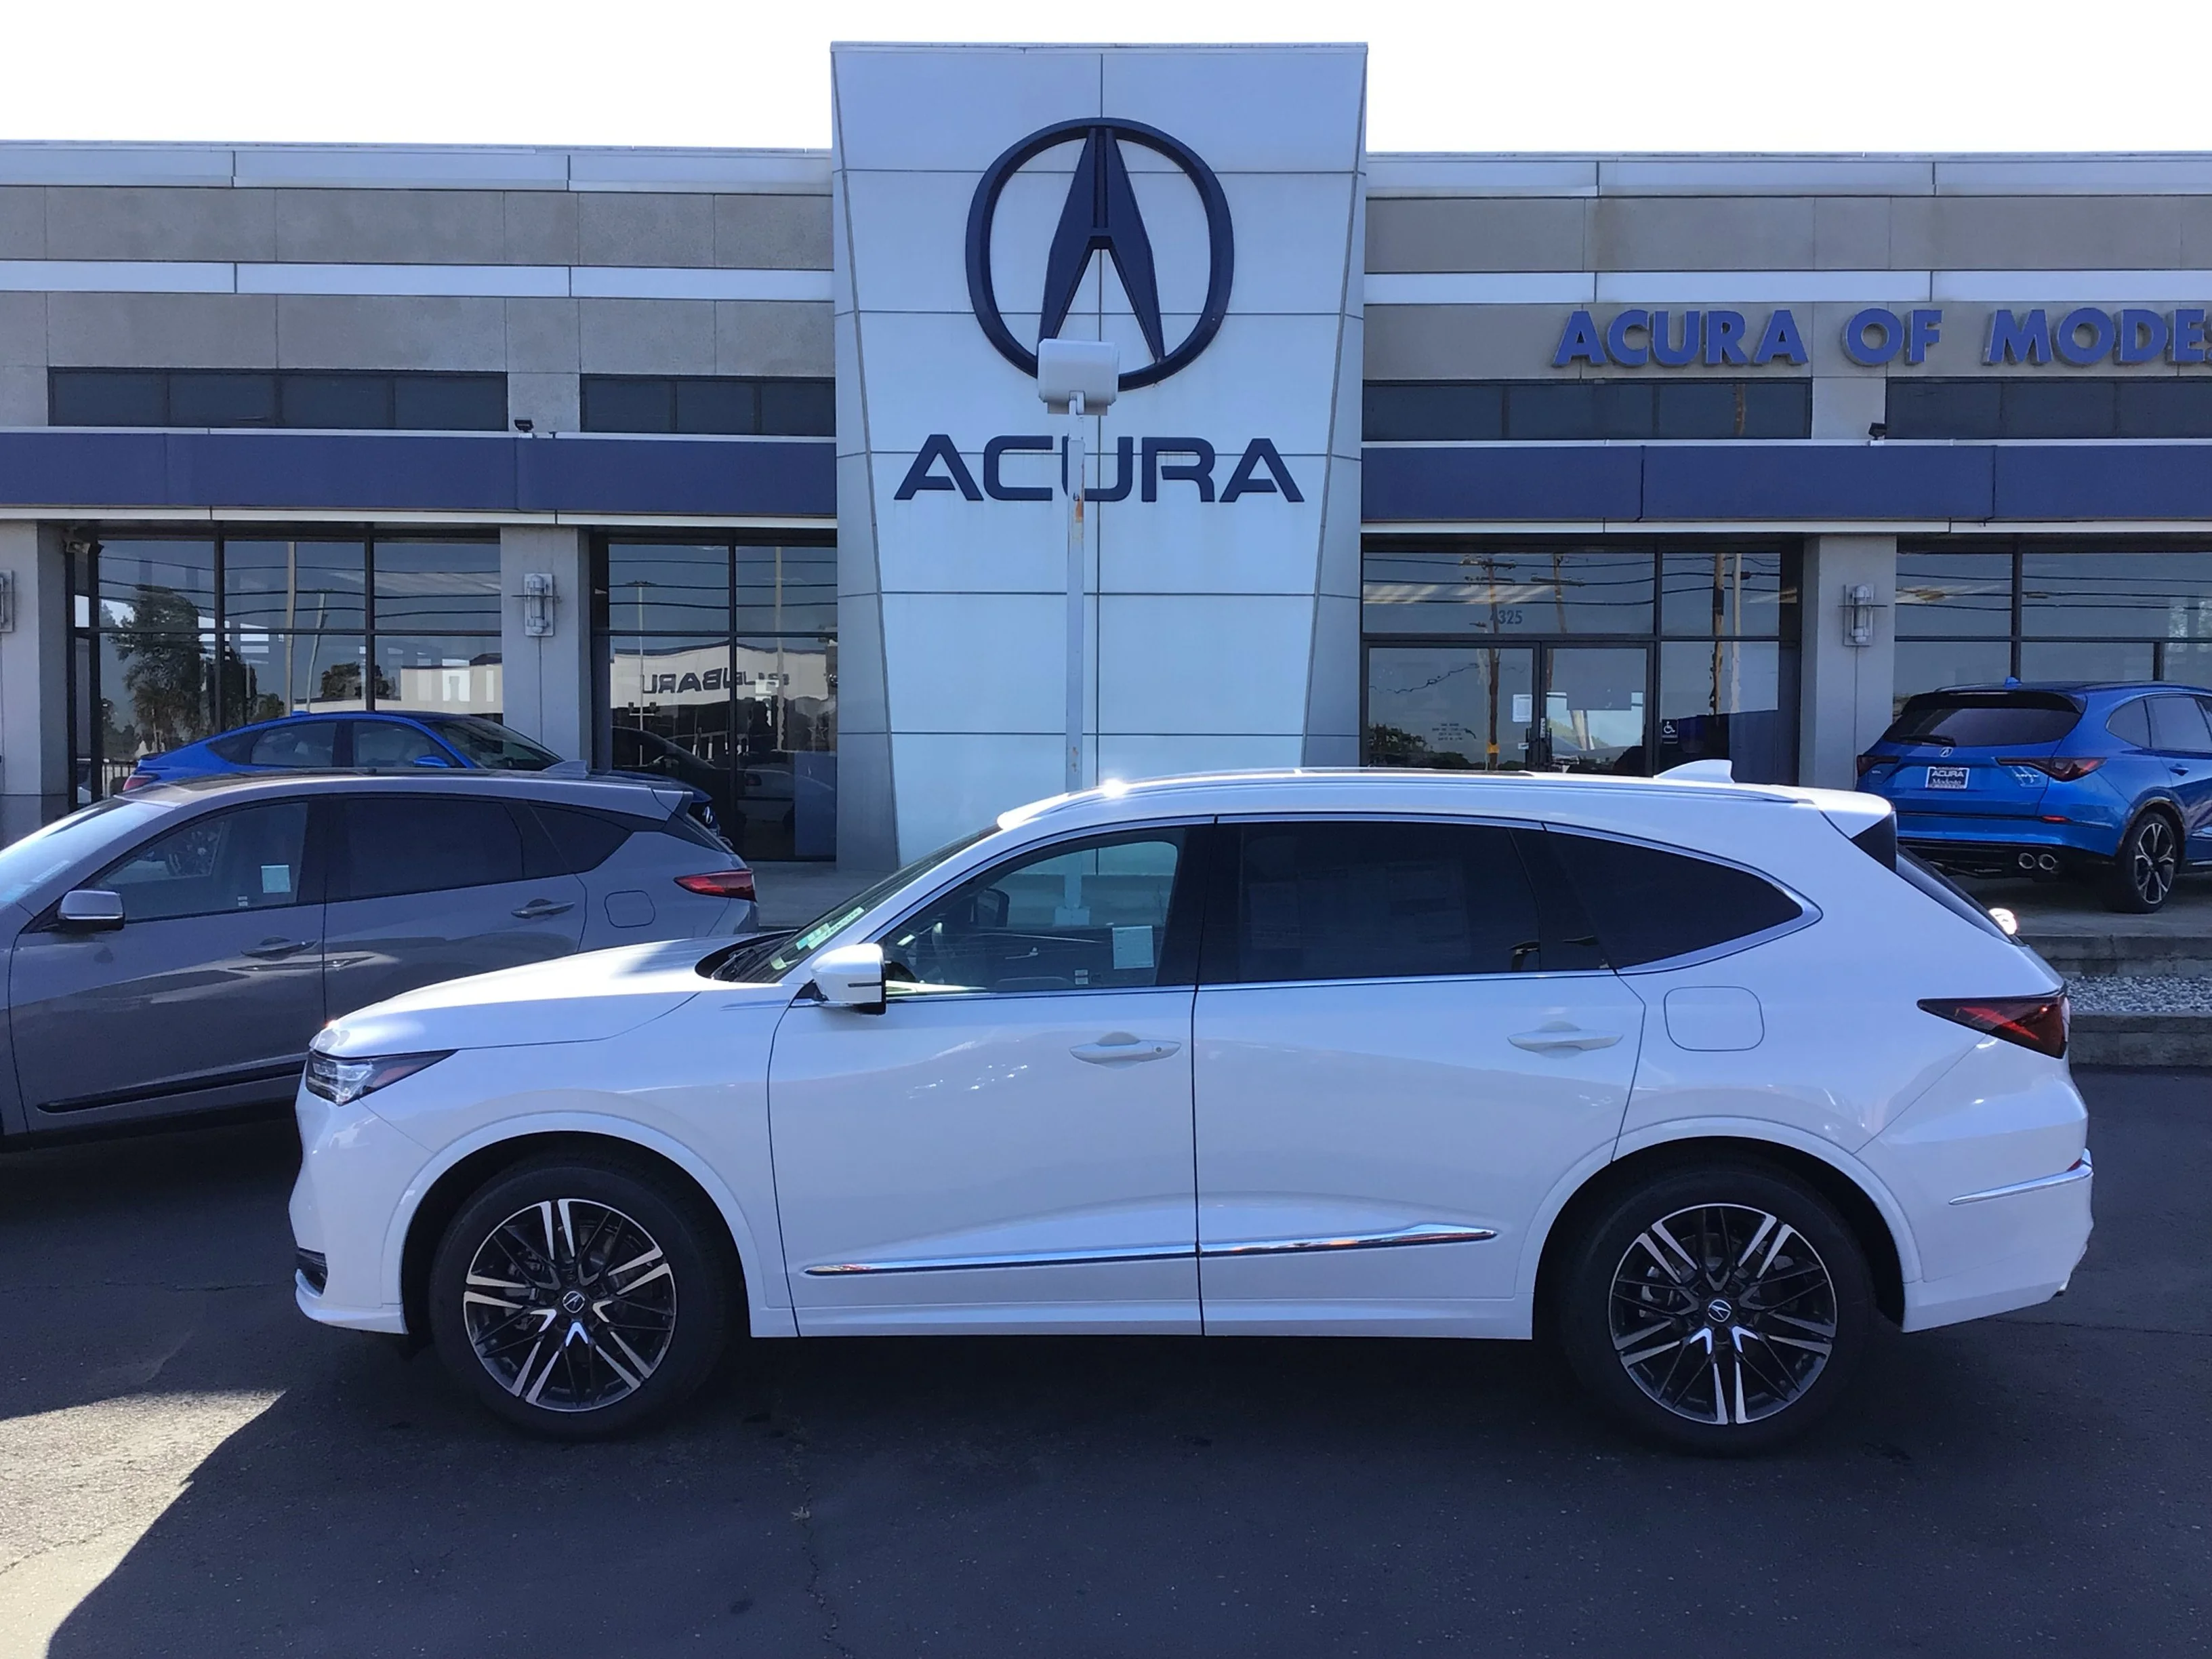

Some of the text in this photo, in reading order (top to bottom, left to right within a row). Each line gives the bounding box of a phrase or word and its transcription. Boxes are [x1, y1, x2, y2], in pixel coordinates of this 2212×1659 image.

[1552, 307, 2212, 367] ACURA OF MODE
[893, 434, 1305, 503] ACURA
